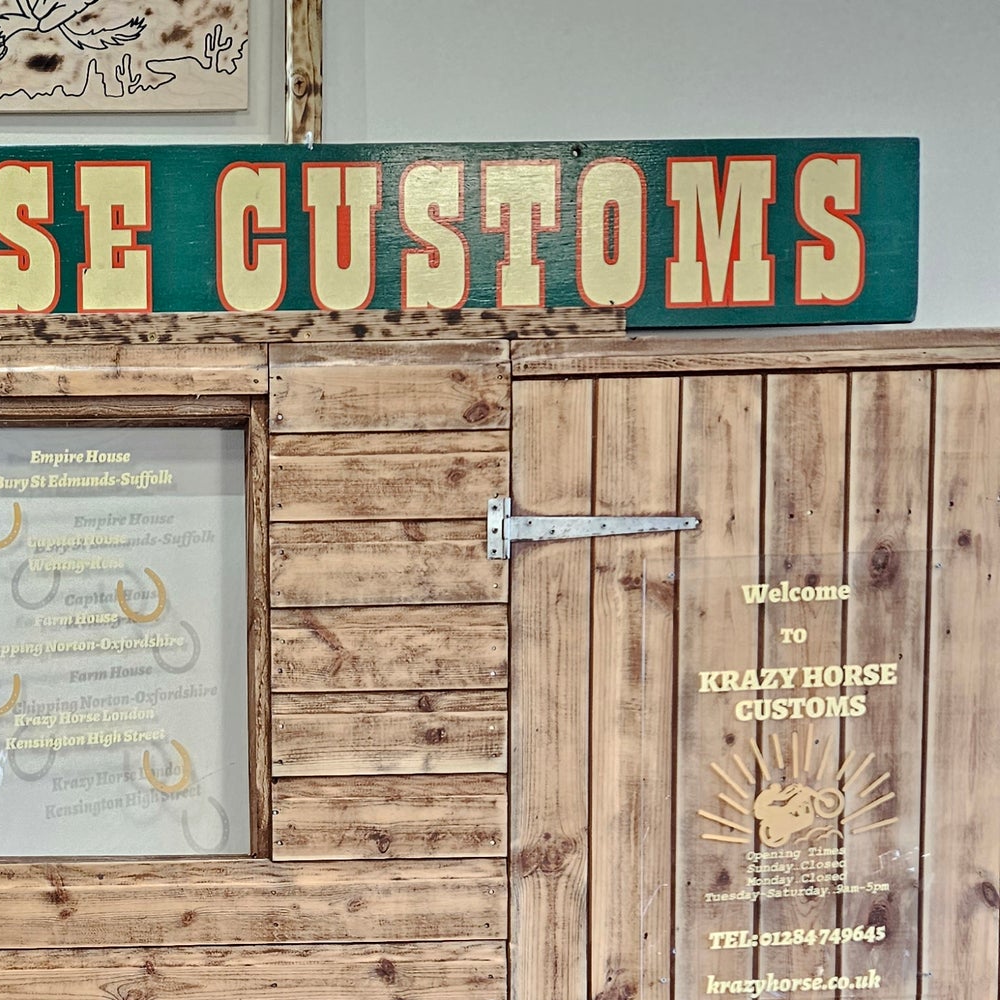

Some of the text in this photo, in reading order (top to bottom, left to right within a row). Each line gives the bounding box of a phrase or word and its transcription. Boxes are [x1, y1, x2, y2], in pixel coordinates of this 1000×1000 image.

[215, 153, 865, 311] CUSTOMS
[30, 449, 131, 467] Empire House
[30, 475, 46, 488] St
[48, 470, 173, 489] Edmunds-Suffolk
[742, 581, 850, 604] Welcome
[34, 613, 73, 627] Farm
[75, 612, 119, 626] House
[45, 635, 185, 653] Norton-Oxfordshire
[780, 628, 807, 644] TO
[698, 663, 898, 692] KRAZY HORSE
[14, 707, 155, 727] Krazy Horse London
[735, 695, 866, 721] CUSTOMS
[5, 735, 86, 751] Kensington
[86, 732, 121, 749] High
[122, 728, 166, 743] Street
[746, 846, 847, 863] Opening Times
[706, 969, 881, 999] krazyhorse.co.uk
